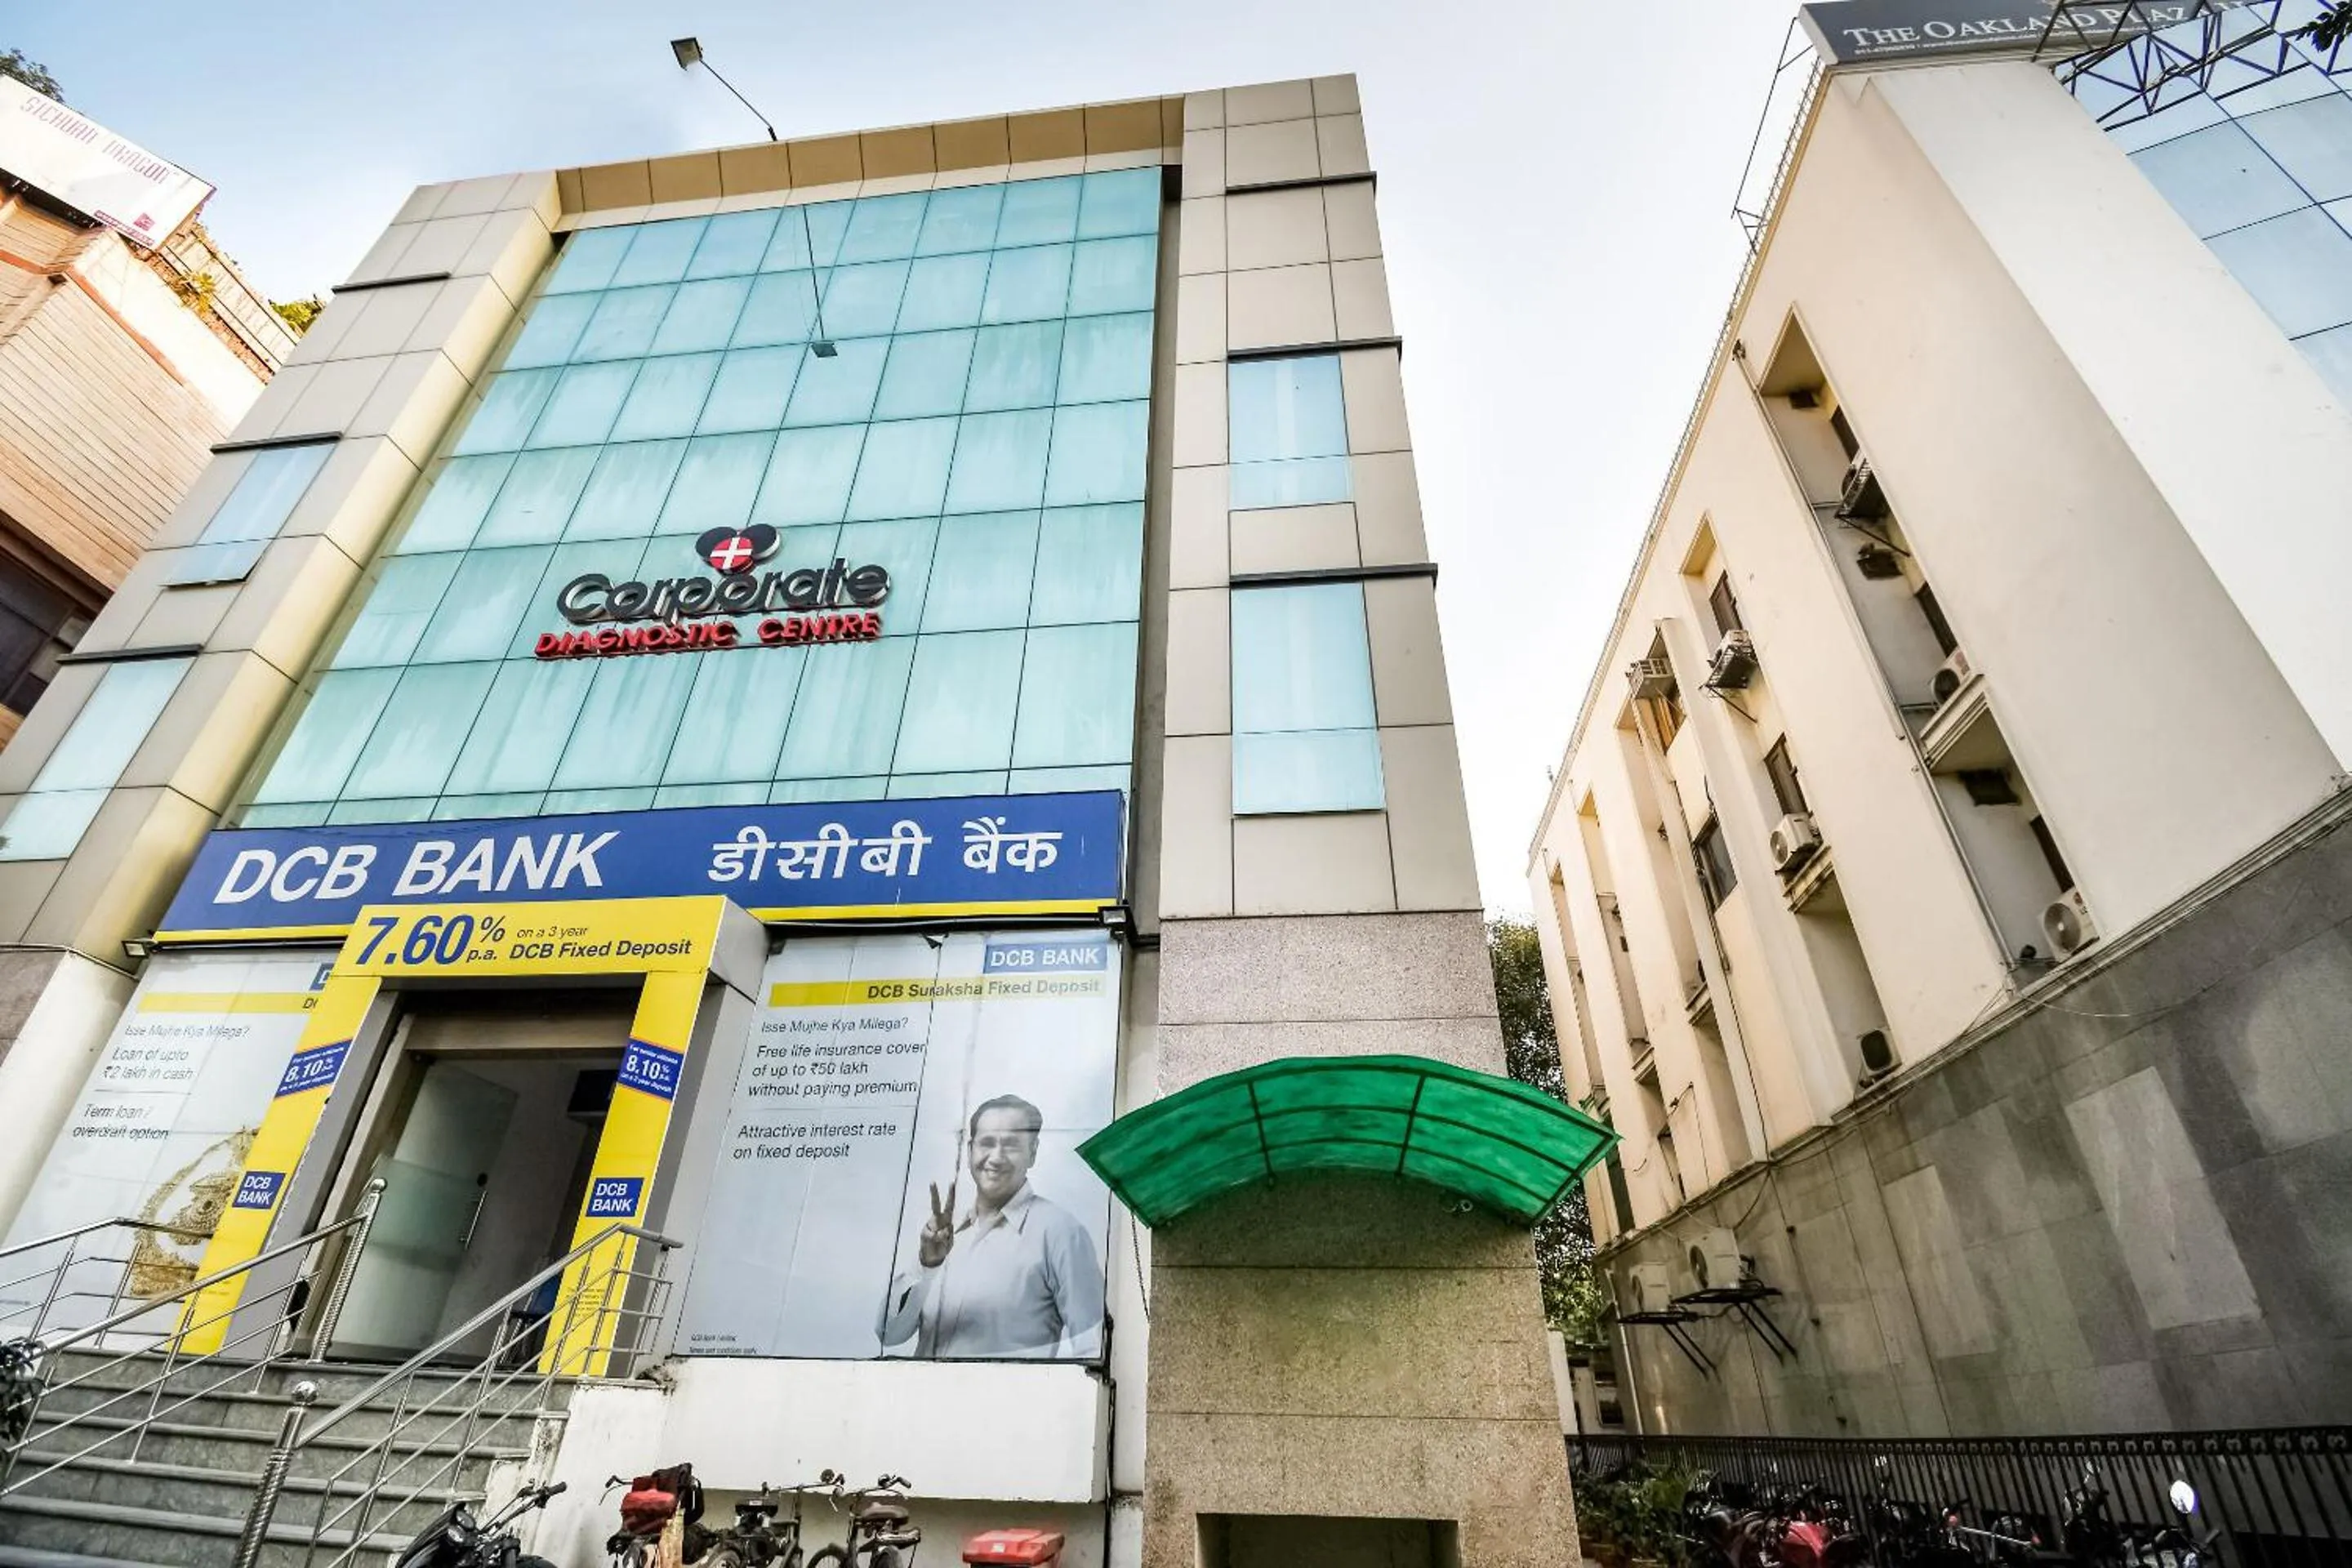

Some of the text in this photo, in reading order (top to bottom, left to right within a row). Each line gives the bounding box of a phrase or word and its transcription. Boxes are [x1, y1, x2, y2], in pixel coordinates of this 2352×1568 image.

[1843, 27, 1920, 47] THE
[1923, 13, 2097, 38] OAKLAND
[557, 557, 893, 626] Corporate
[535, 612, 883, 658] DIAGNOSTIC CENTRE
[707, 816, 1062, 882] डीसीबी बैंक
[212, 831, 621, 904] DCB BANK
[517, 926, 589, 939] on a 3 year
[466, 939, 692, 963] p.a. DCB Fixed Deposit
[991, 947, 1099, 967] DCB BANK
[867, 979, 1100, 999] DCB Suraksha Fixed Deposit
[761, 1021, 786, 1033] Isse
[831, 1019, 855, 1033] Kya
[859, 1018, 908, 1032] Milega?
[112, 1046, 142, 1061] Loan
[145, 1049, 159, 1061] of
[757, 1043, 927, 1058] Free life insurance cover
[149, 1067, 161, 1079] in
[163, 1068, 193, 1080] cash
[285, 1059, 324, 1083] 8.10
[626, 1054, 661, 1080] 8.10
[752, 1064, 766, 1076] of
[771, 1067, 788, 1079] up
[792, 1065, 806, 1076] to
[840, 1062, 868, 1075] lakh
[748, 1080, 917, 1098] without paying premium
[84, 1104, 114, 1118] Term
[116, 1105, 143, 1119] loan
[73, 1125, 170, 1140] overdraft option
[738, 1123, 897, 1138] Attractive interest rate
[733, 1143, 850, 1160] on fixed deposit
[244, 1176, 272, 1189] DCB
[596, 1183, 628, 1196] DCB
[238, 1190, 274, 1205] BANK
[591, 1198, 634, 1212] BANK
